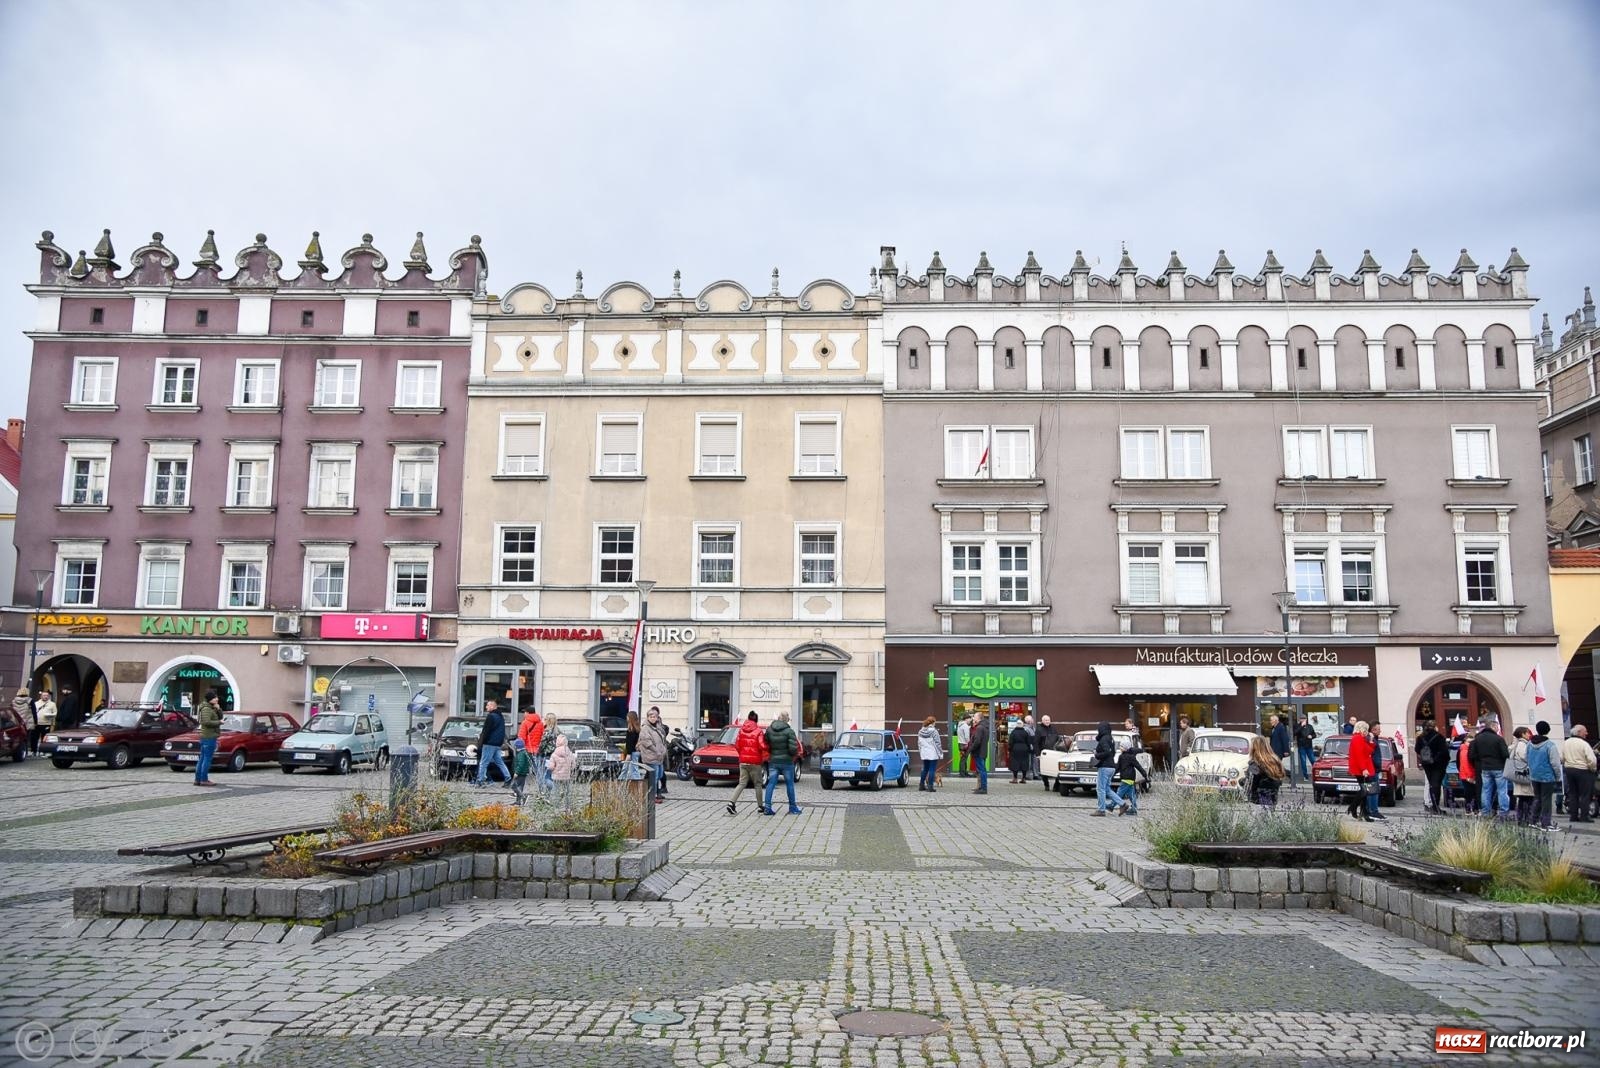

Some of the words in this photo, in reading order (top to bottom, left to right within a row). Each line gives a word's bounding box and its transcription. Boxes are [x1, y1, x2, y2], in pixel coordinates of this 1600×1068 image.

[32, 614, 108, 626] TABAC
[140, 615, 249, 636] KANTOR
[509, 628, 604, 641] RESTAURACJA
[645, 627, 697, 643] HIRO
[1136, 646, 1222, 664] Manufaktura
[1226, 647, 1273, 663] Lodów
[179, 669, 219, 679] KANTOR
[960, 672, 1025, 691] żabka
